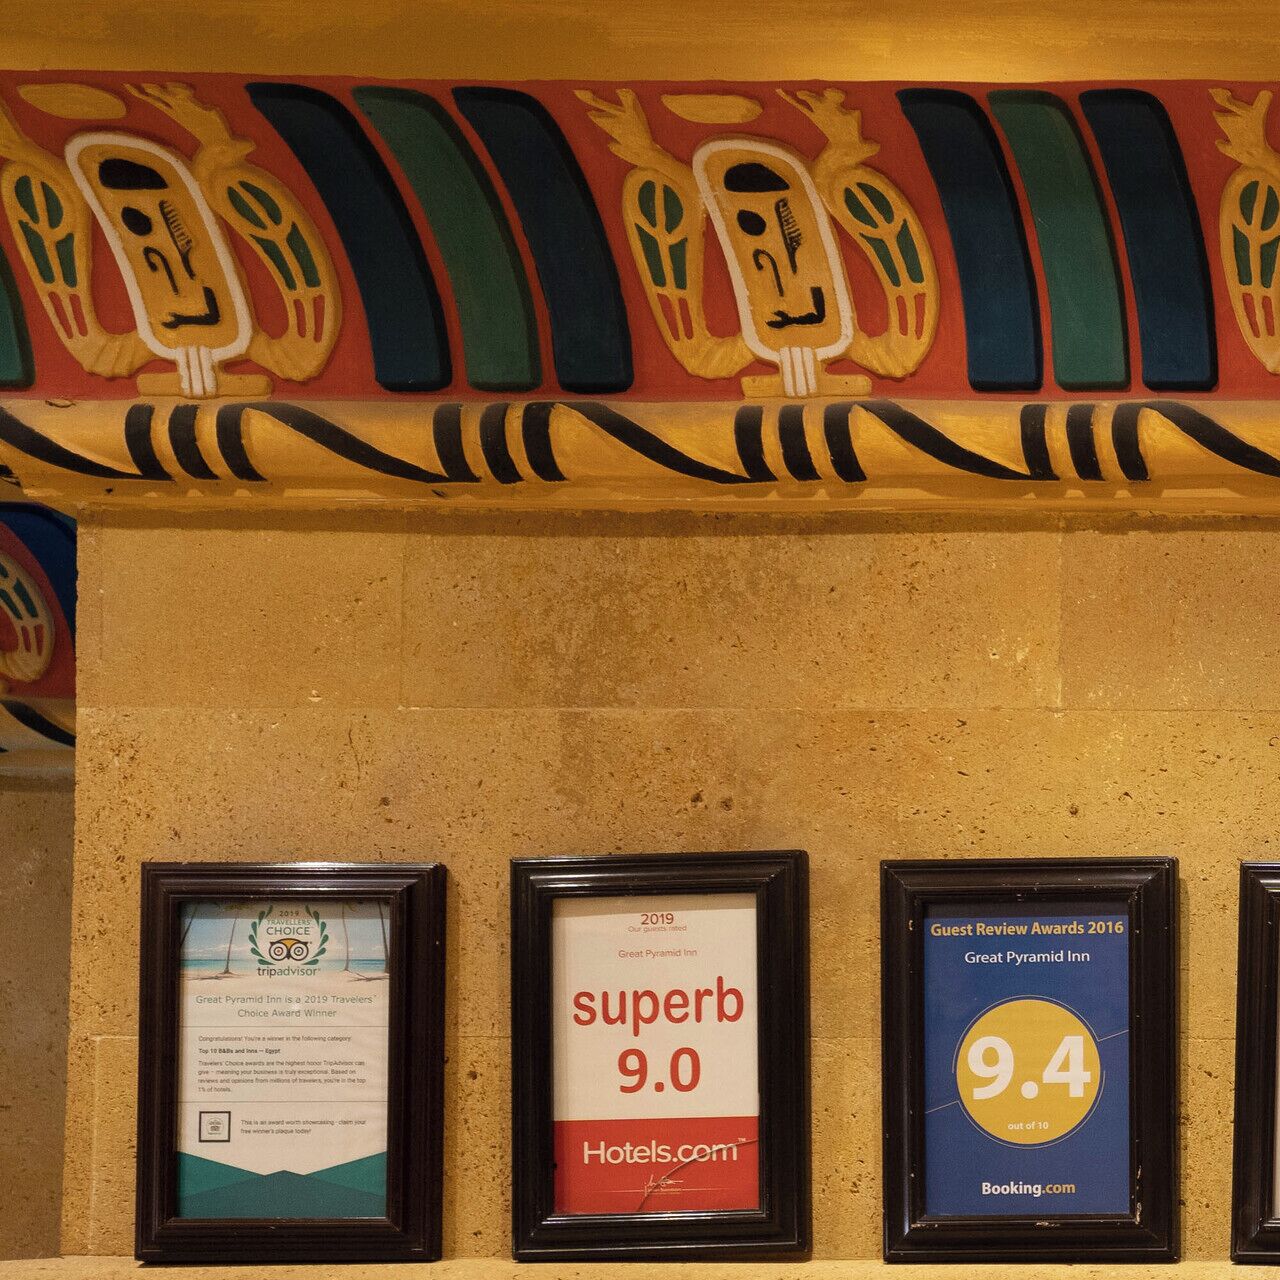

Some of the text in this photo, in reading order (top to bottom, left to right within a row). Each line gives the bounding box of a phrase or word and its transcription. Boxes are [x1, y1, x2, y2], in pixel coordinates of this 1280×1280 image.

[640, 912, 674, 925] 2019
[930, 921, 1124, 936] Guest Review Awards 2016
[618, 948, 698, 960] Great Pyramid Inn
[964, 950, 1090, 966] Great Pyramid Inn
[196, 995, 222, 1004] Great
[225, 995, 263, 1006] Pyramid
[266, 995, 282, 1004] Inn
[284, 995, 292, 1004] is
[304, 995, 328, 1004] 2019
[573, 976, 744, 1037] superb
[237, 1009, 337, 1018] Choice Award Winner
[618, 1047, 701, 1094] 9.0
[967, 1035, 1092, 1100] 9.4
[1008, 1121, 1049, 1130] out of 10
[982, 1182, 1076, 1197] Booking.com
